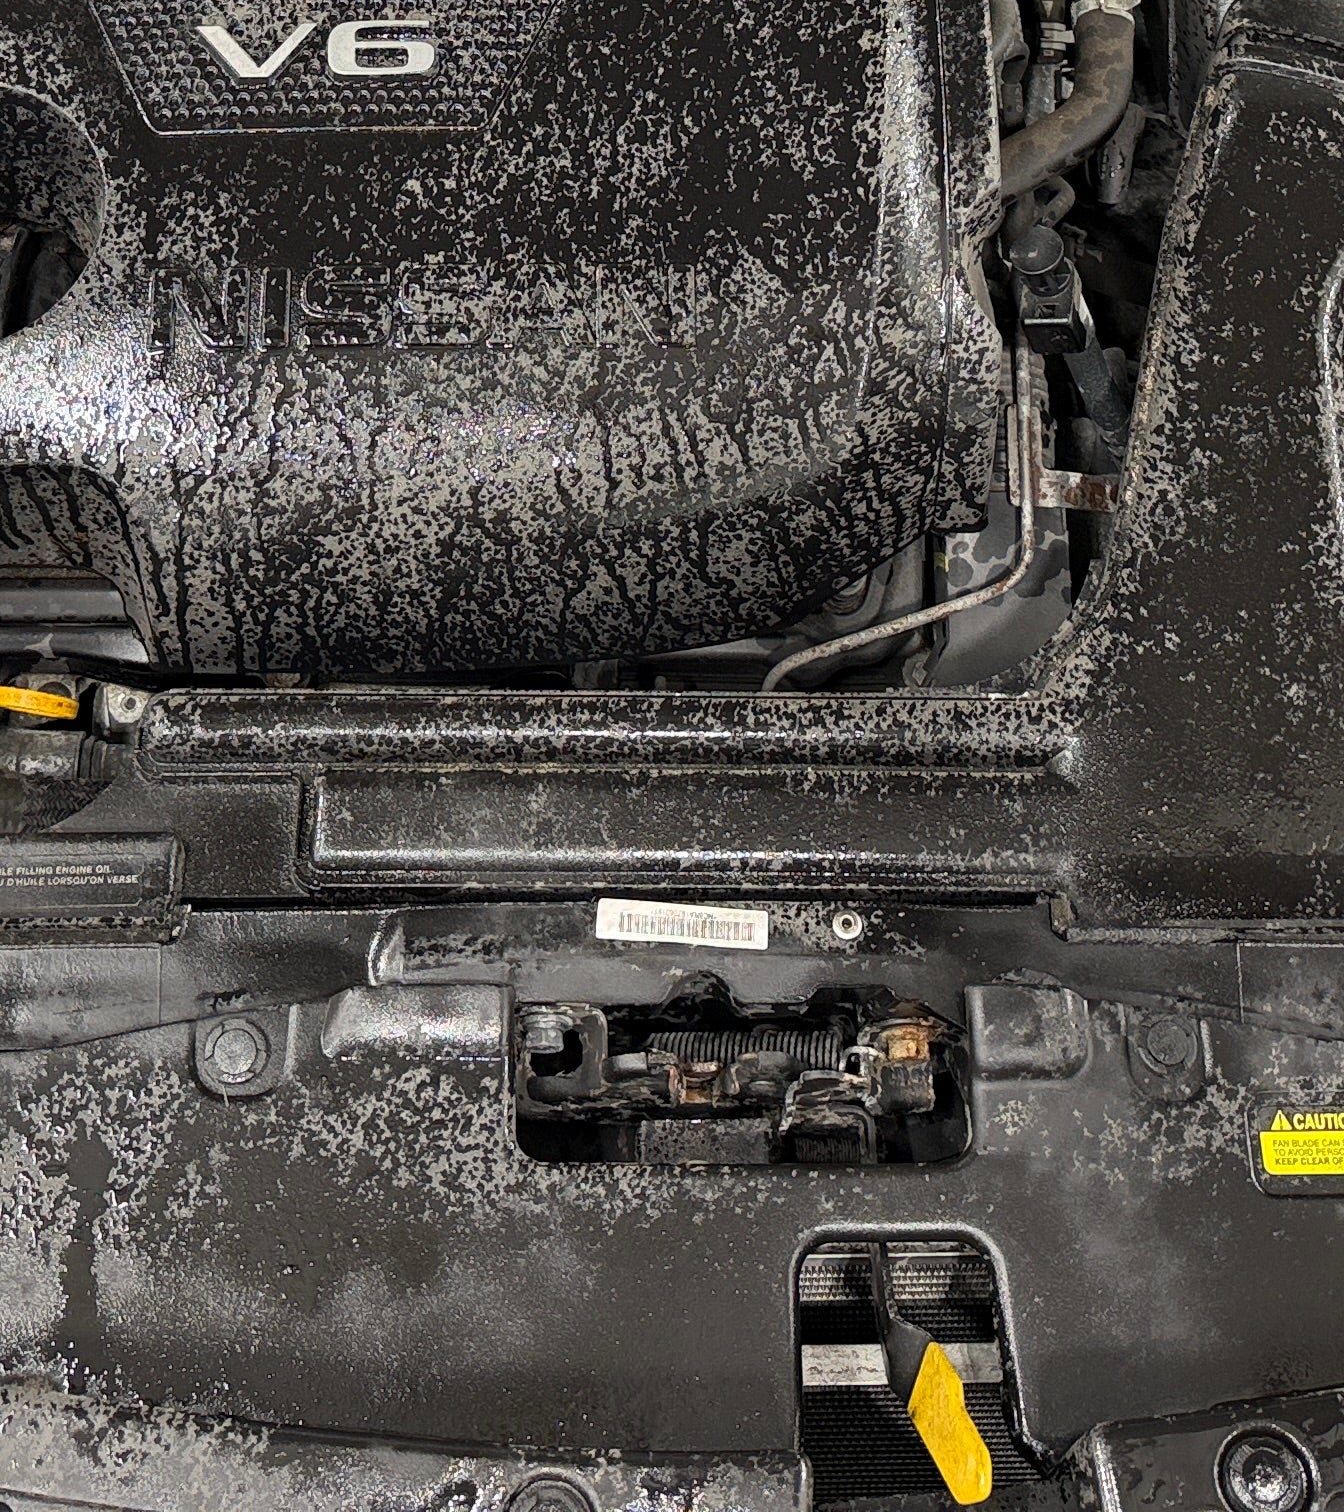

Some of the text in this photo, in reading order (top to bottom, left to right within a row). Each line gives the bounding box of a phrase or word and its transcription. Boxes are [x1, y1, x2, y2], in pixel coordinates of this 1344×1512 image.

[195, 20, 436, 80] V6
[16, 867, 53, 875] FILLING
[56, 866, 92, 874] ENGINE
[48, 875, 104, 885] LORSQU'ON
[107, 875, 139, 884] VERSE
[1273, 1139, 1289, 1147] FAN
[1292, 1139, 1320, 1147] BLADE
[1301, 1157, 1330, 1165] CLEAR
[1332, 1157, 1344, 1165] OF
